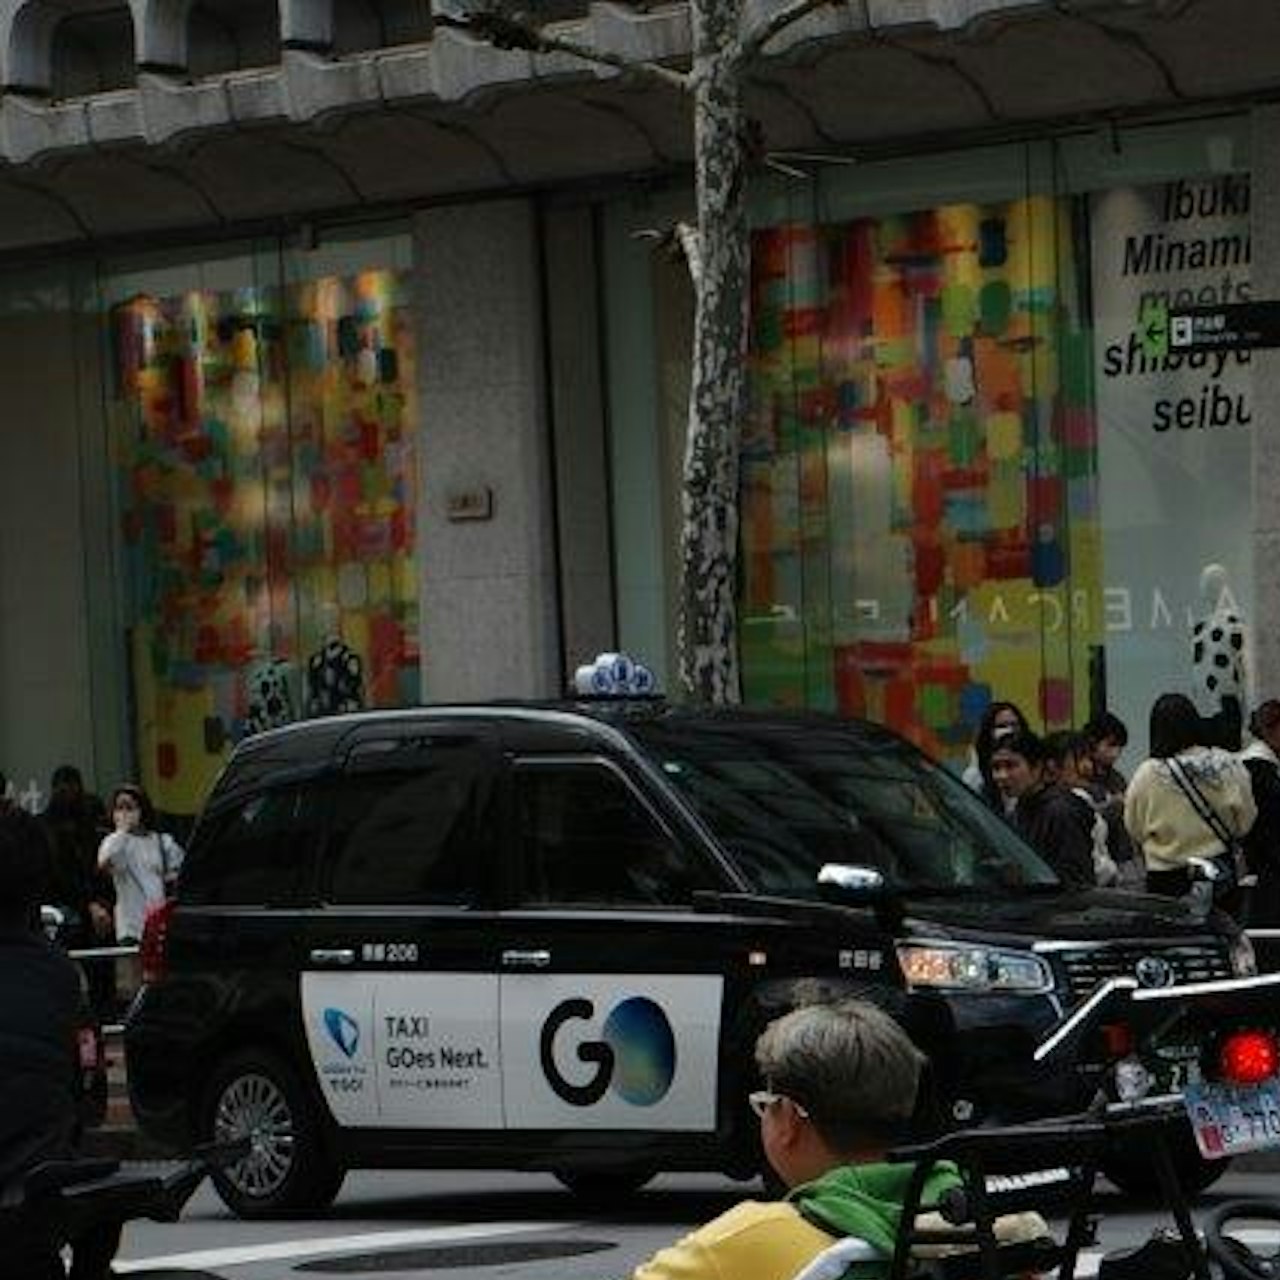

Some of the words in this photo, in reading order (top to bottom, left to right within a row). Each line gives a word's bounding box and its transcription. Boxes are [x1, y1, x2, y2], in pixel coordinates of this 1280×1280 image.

[1163, 173, 1251, 222] Ibuki
[1122, 233, 1252, 276] Minami
[384, 1016, 429, 1038] TAXI
[385, 1047, 435, 1069] GOes
[440, 1047, 489, 1069] Next.
[539, 996, 676, 1108] GO
